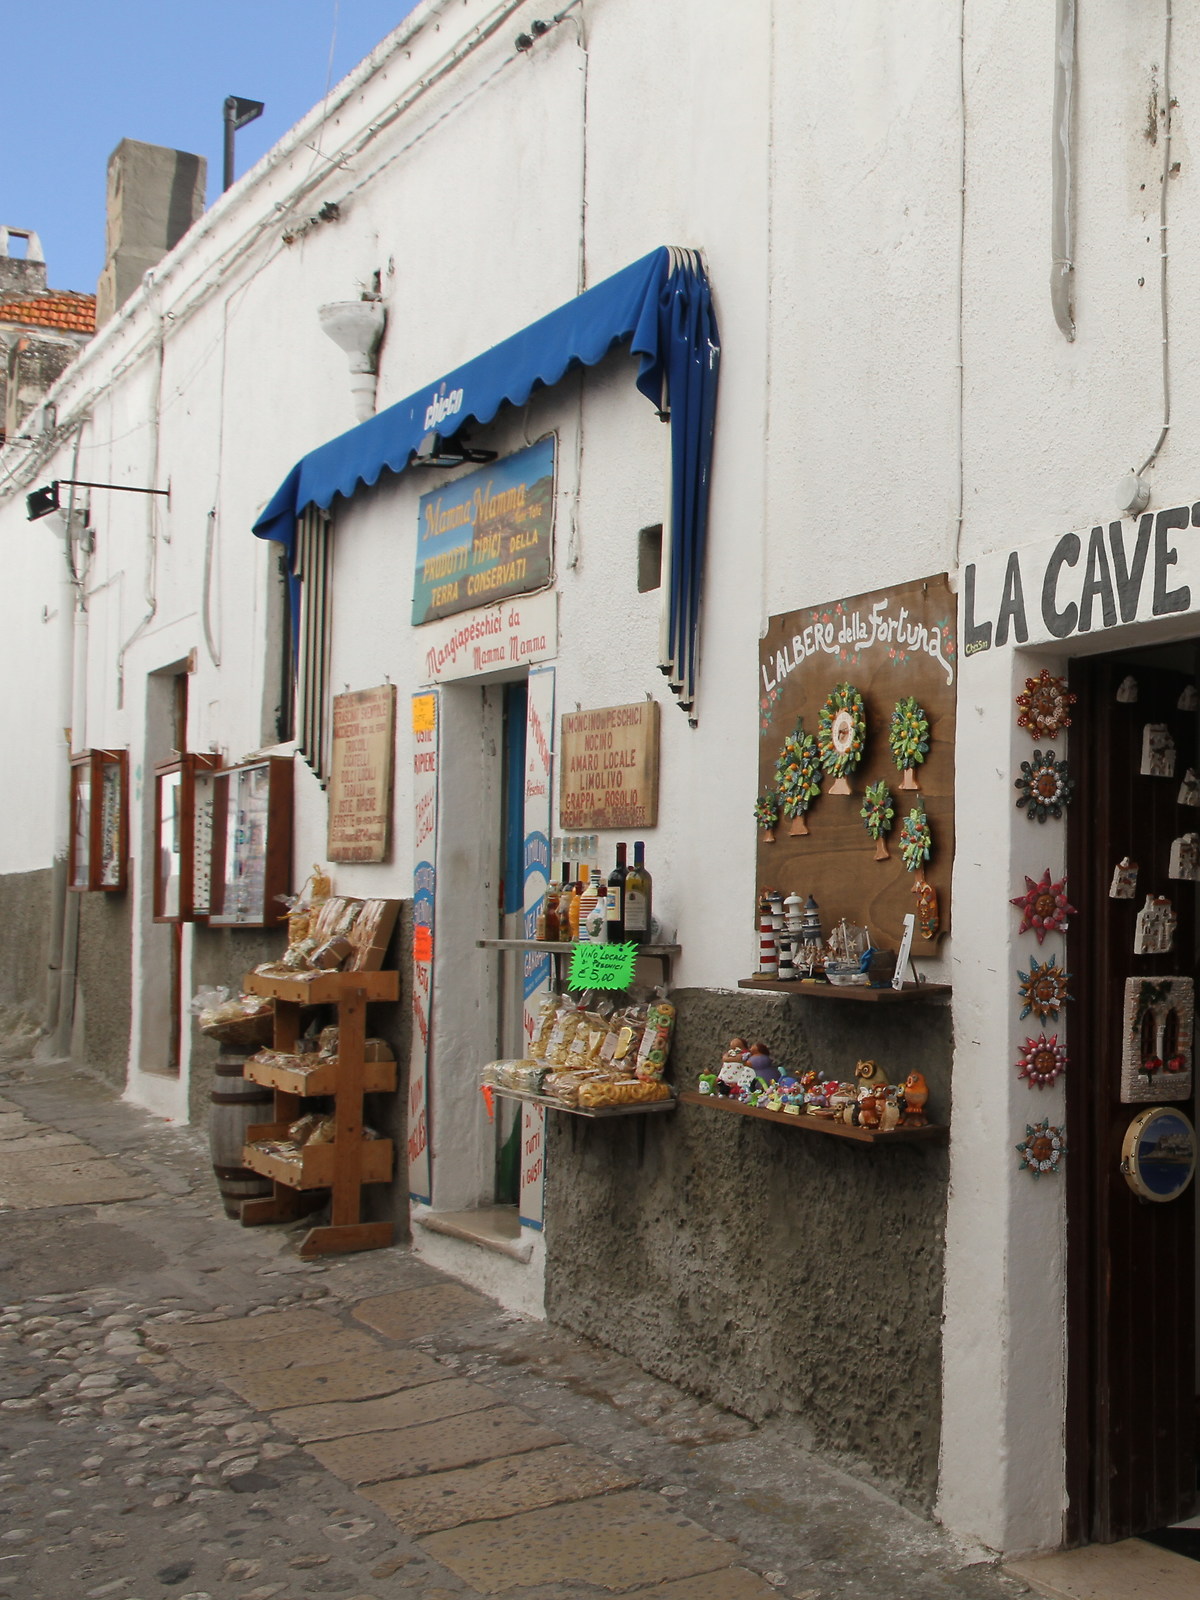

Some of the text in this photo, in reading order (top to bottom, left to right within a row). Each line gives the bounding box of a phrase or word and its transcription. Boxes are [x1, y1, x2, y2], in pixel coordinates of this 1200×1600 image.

[422, 497, 471, 542] Mamma
[472, 480, 526, 526] Mamma
[509, 528, 539, 554] DELLA
[431, 558, 526, 608] TERRA CONSERVATI
[964, 551, 1029, 658] LA
[508, 608, 521, 628] da
[473, 635, 546, 671] Mamma Mamma
[762, 598, 953, 692] L'ALBERO della Fortuna
[607, 706, 642, 728] PESCHICI
[584, 732, 613, 751] NOCINO
[570, 749, 637, 773] AMARO LOCALE
[580, 770, 623, 791] LIMOLIVO
[565, 793, 595, 810] GRAPPA
[604, 789, 638, 807] ROSOLIO
[580, 947, 628, 962] VINO LOCALE
[589, 968, 615, 983] 5,00
